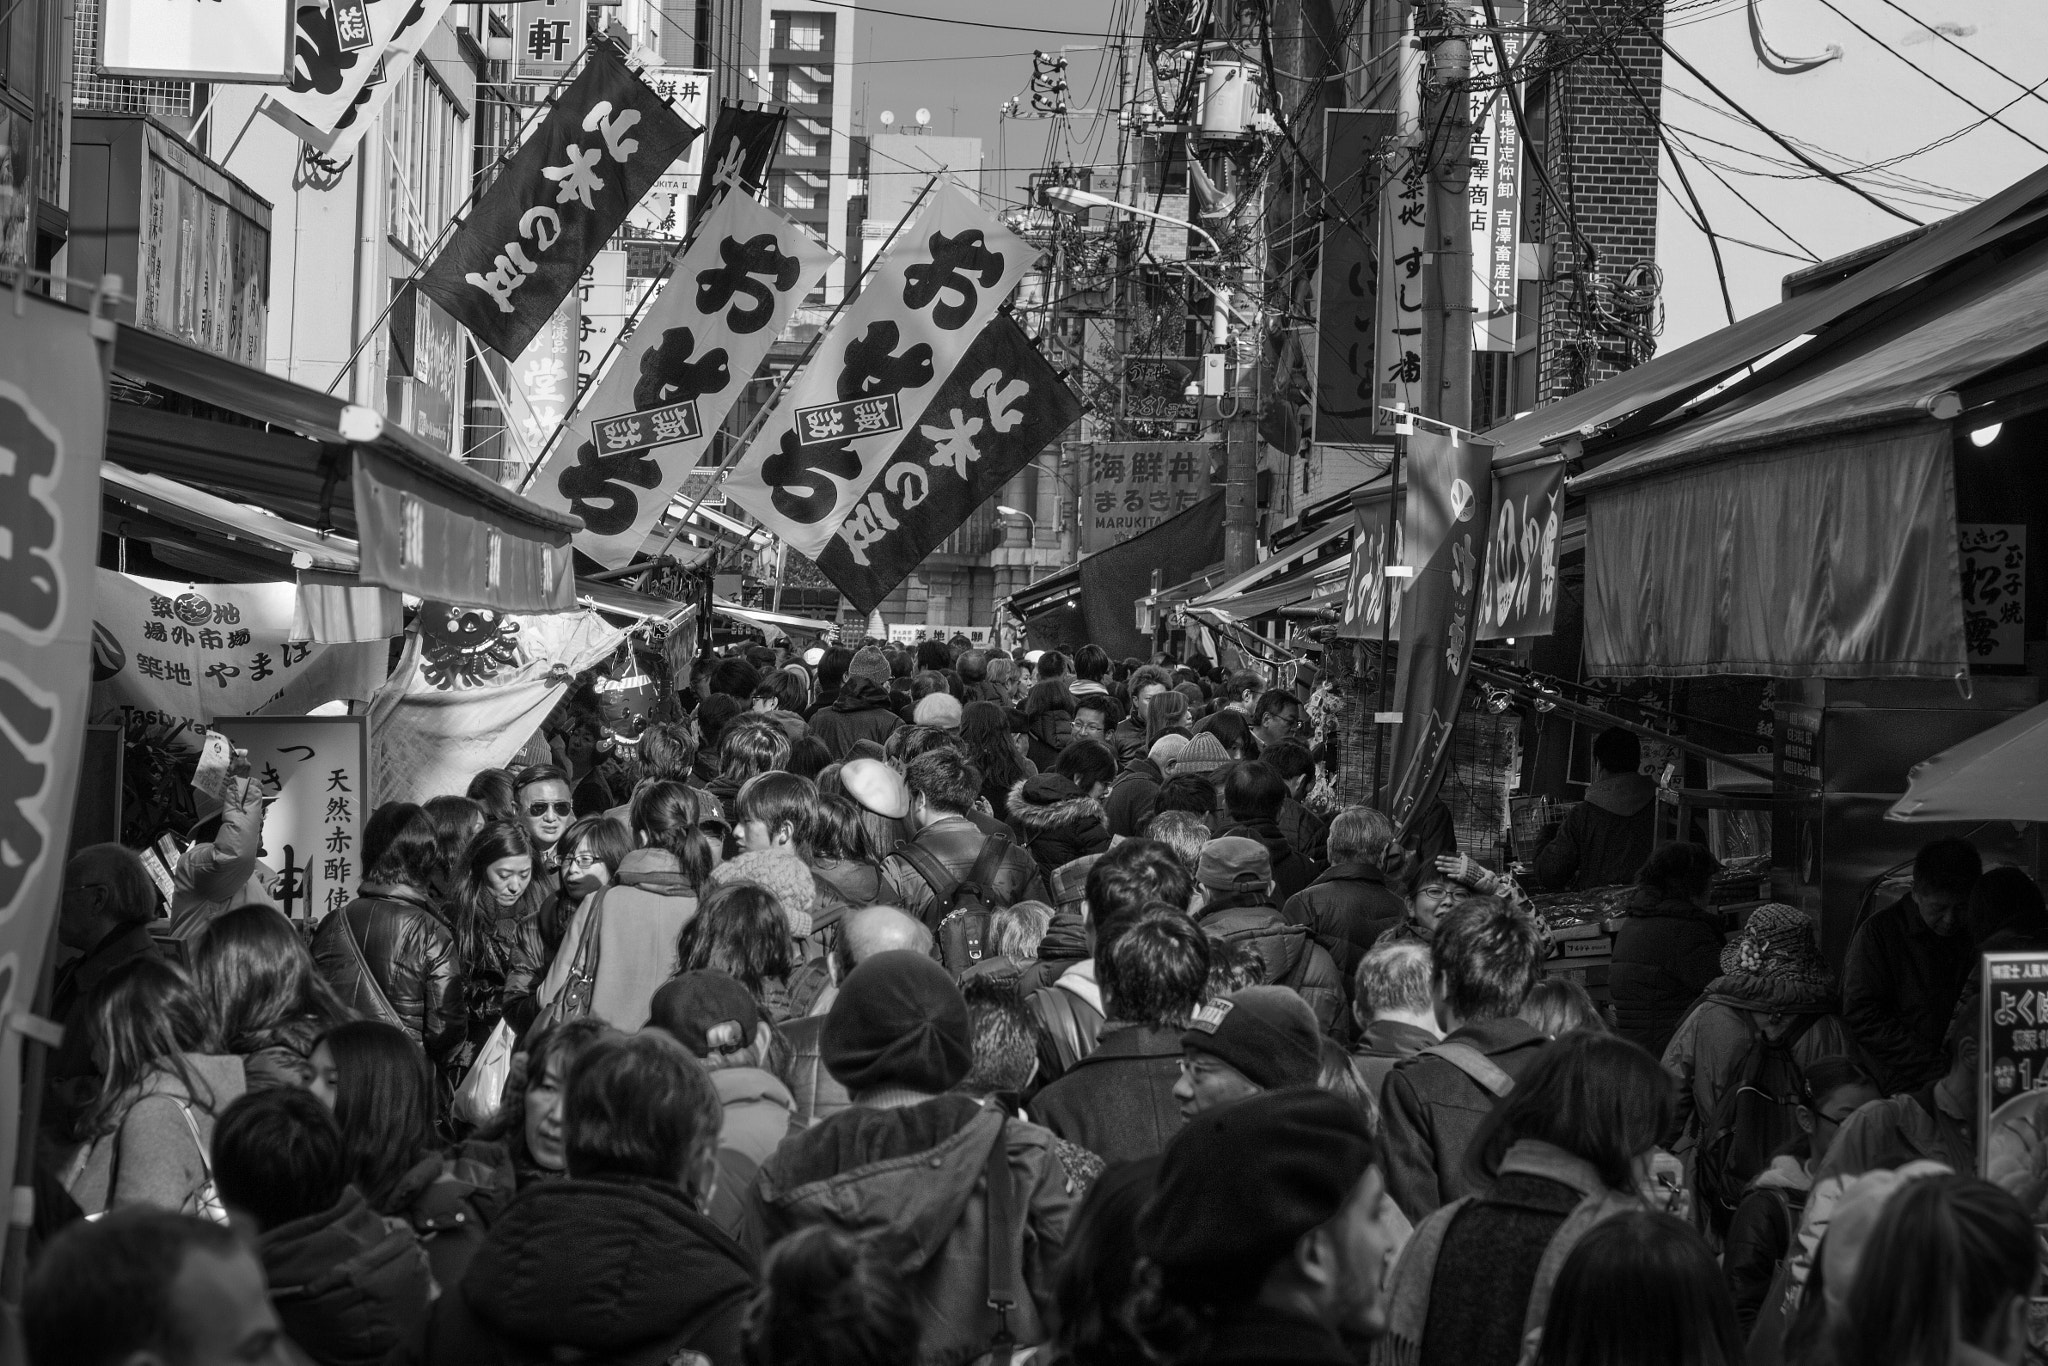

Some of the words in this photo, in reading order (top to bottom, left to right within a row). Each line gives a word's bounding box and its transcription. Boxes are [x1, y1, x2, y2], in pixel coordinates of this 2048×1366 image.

[527, 0, 571, 62] 軒
[1493, 208, 1513, 315] 吉澤畜産仕入
[1094, 452, 1199, 484] 海鮮丼
[1094, 489, 1198, 514] まるきた
[1095, 517, 1162, 529] MARUKITA
[2000, 544, 2023, 624] 玉子焼
[144, 620, 250, 649] 場外市場
[916, 629, 983, 643] 築地願
[137, 653, 192, 686] 築地
